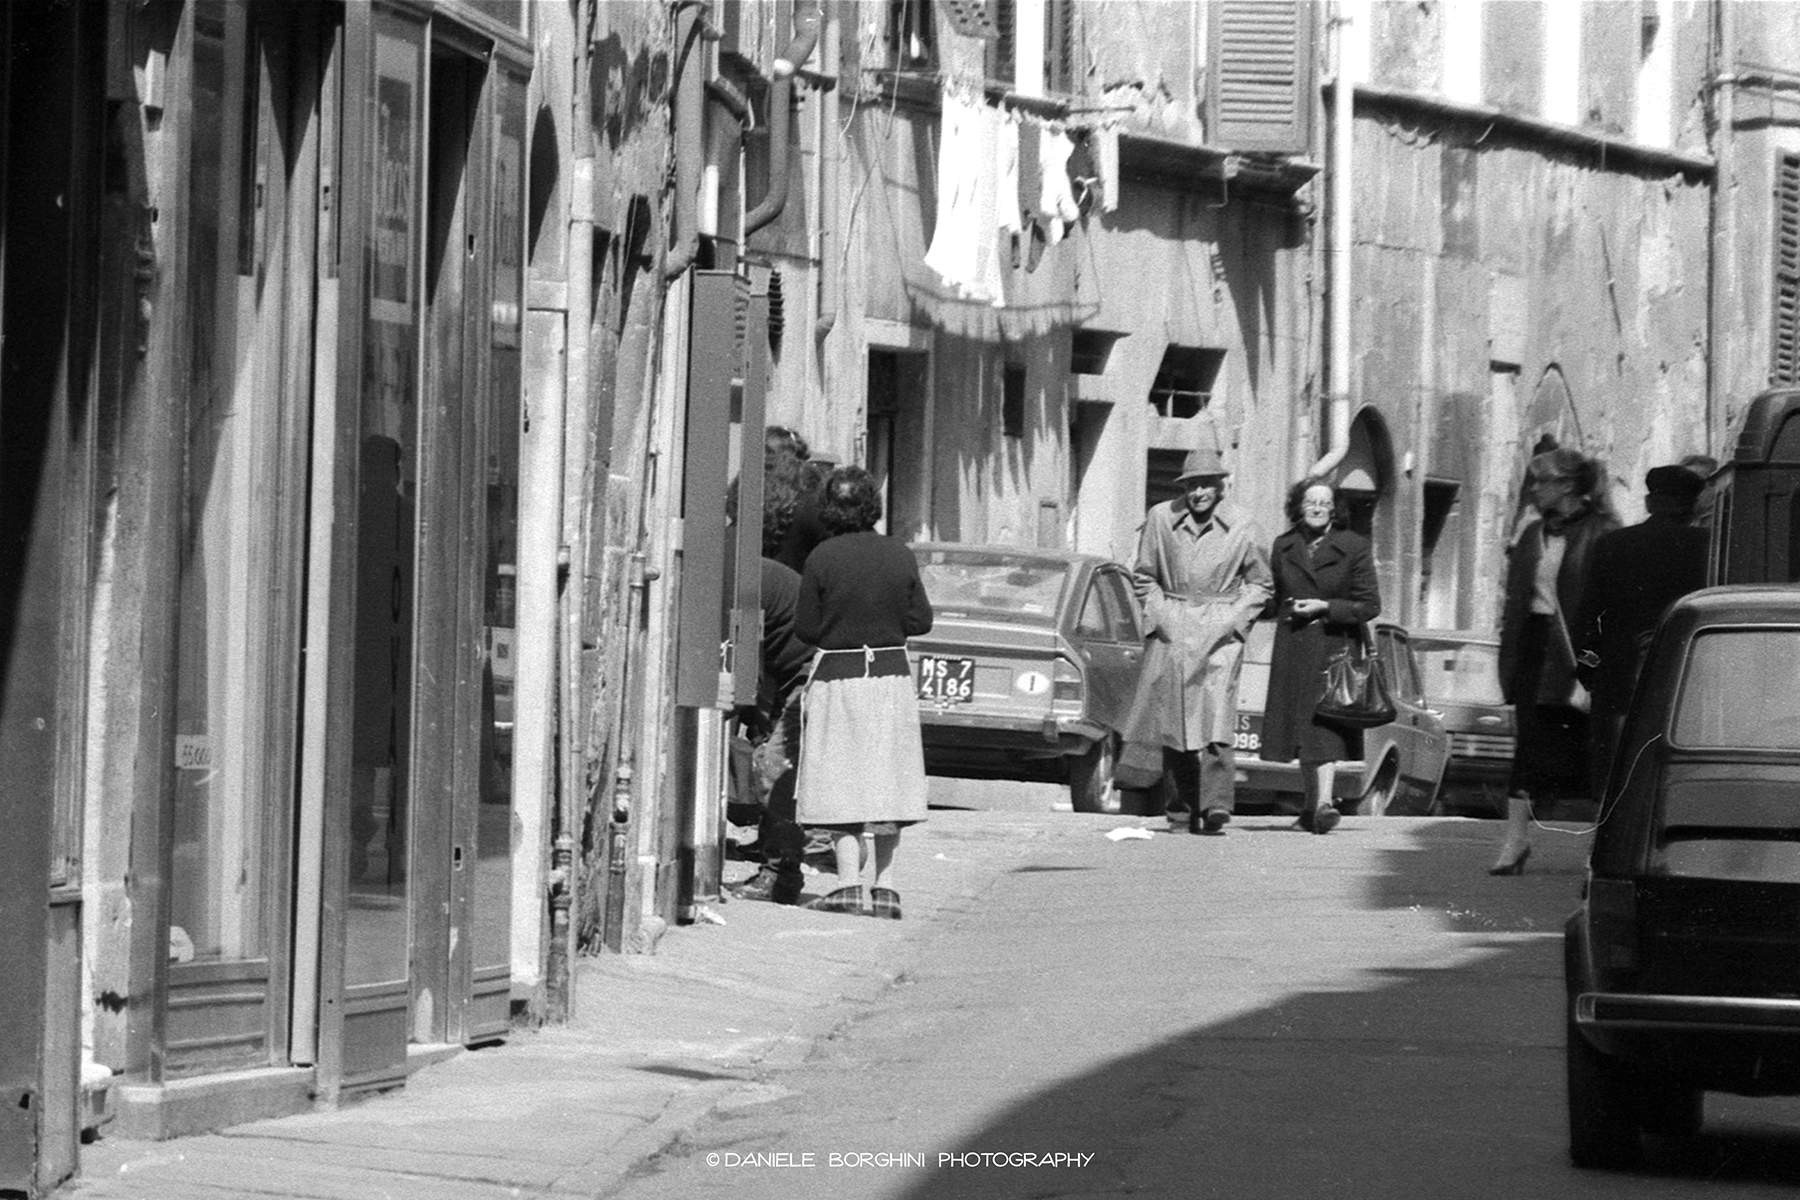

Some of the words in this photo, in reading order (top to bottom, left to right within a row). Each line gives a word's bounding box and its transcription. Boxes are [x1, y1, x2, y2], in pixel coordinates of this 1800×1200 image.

[922, 658, 948, 678] MS
[959, 660, 972, 679] 7
[921, 676, 971, 698] 4186
